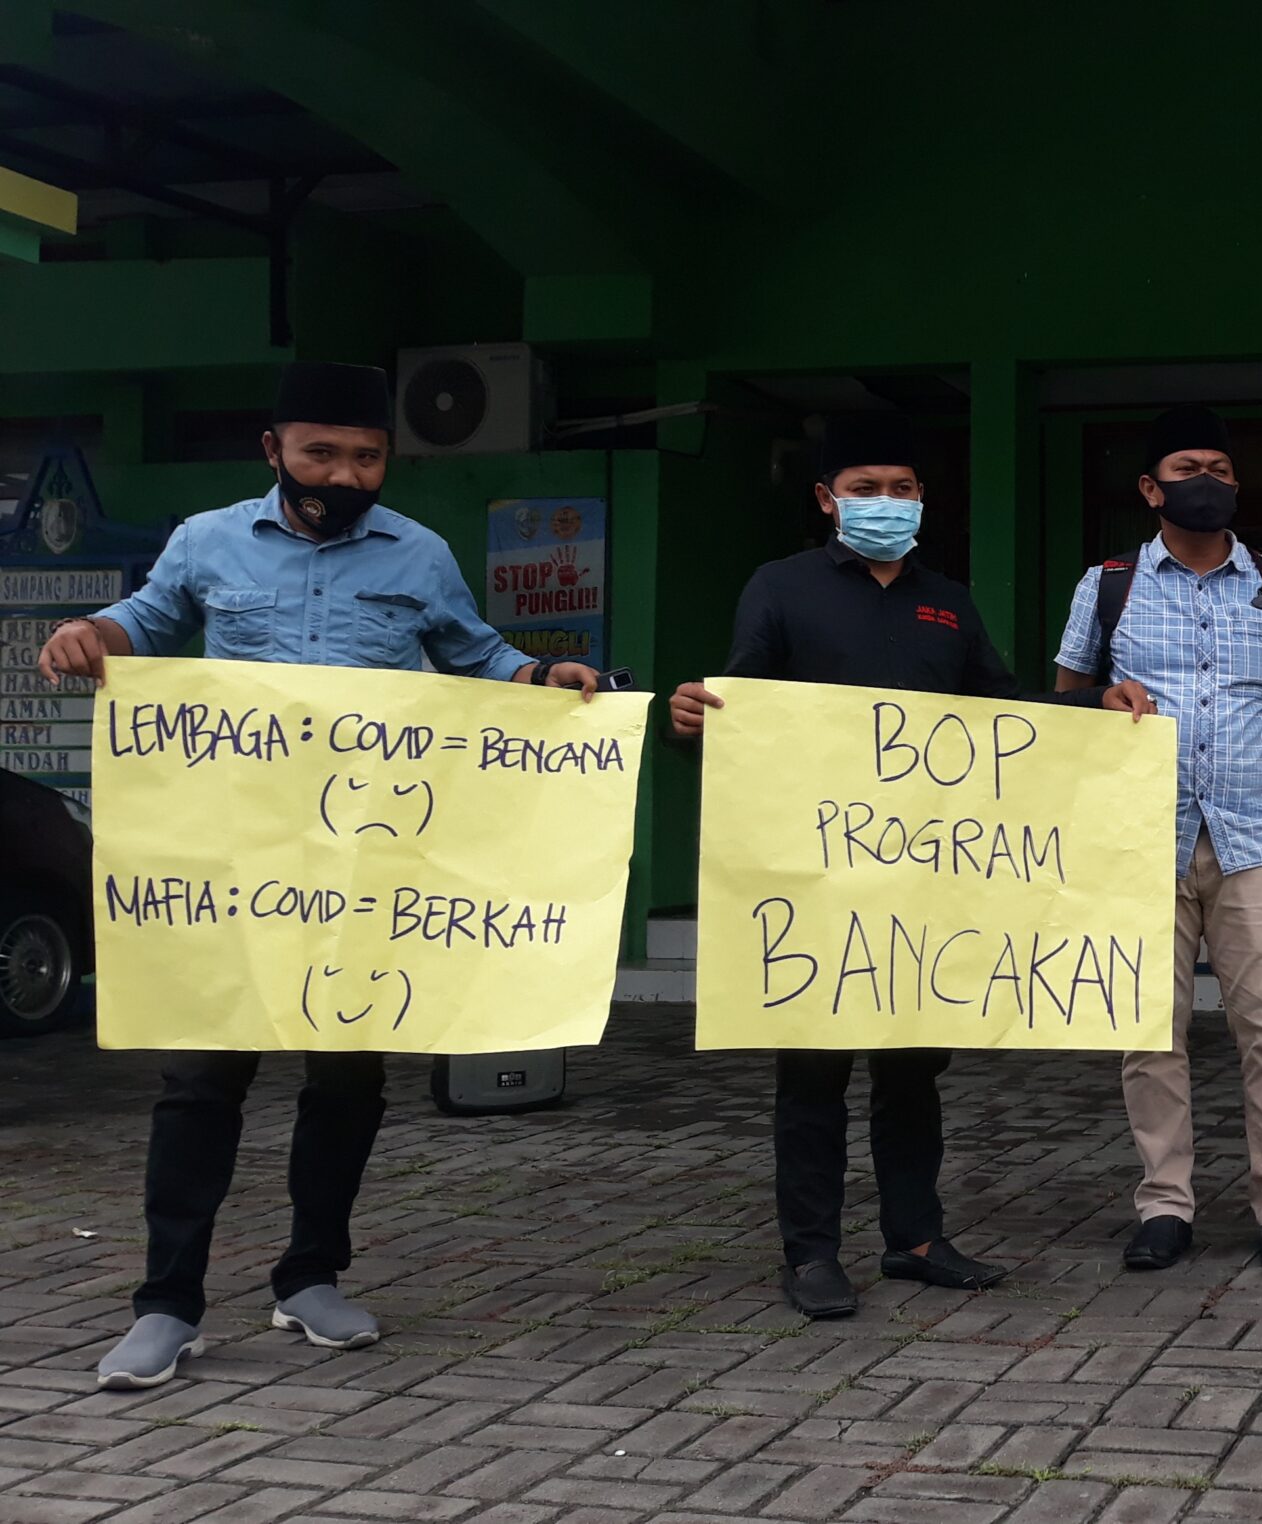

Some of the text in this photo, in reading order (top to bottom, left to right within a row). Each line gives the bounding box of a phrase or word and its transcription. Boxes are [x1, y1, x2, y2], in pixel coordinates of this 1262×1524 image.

[3, 575, 114, 601] SAMPANG BAHARI
[494, 561, 553, 593] STOP
[516, 587, 598, 616] PUNGLI!!
[5, 700, 62, 718] AMAN
[5, 725, 52, 744] RAPI
[329, 714, 433, 761] COVID
[478, 727, 624, 774] BENCANA
[5, 752, 69, 771] INDAH
[873, 702, 1036, 800] BOP
[816, 800, 1065, 884] PROGRAM
[250, 881, 346, 924] COVID
[389, 887, 566, 948] BERKAH
[753, 898, 1142, 1030] BANCAKAN
